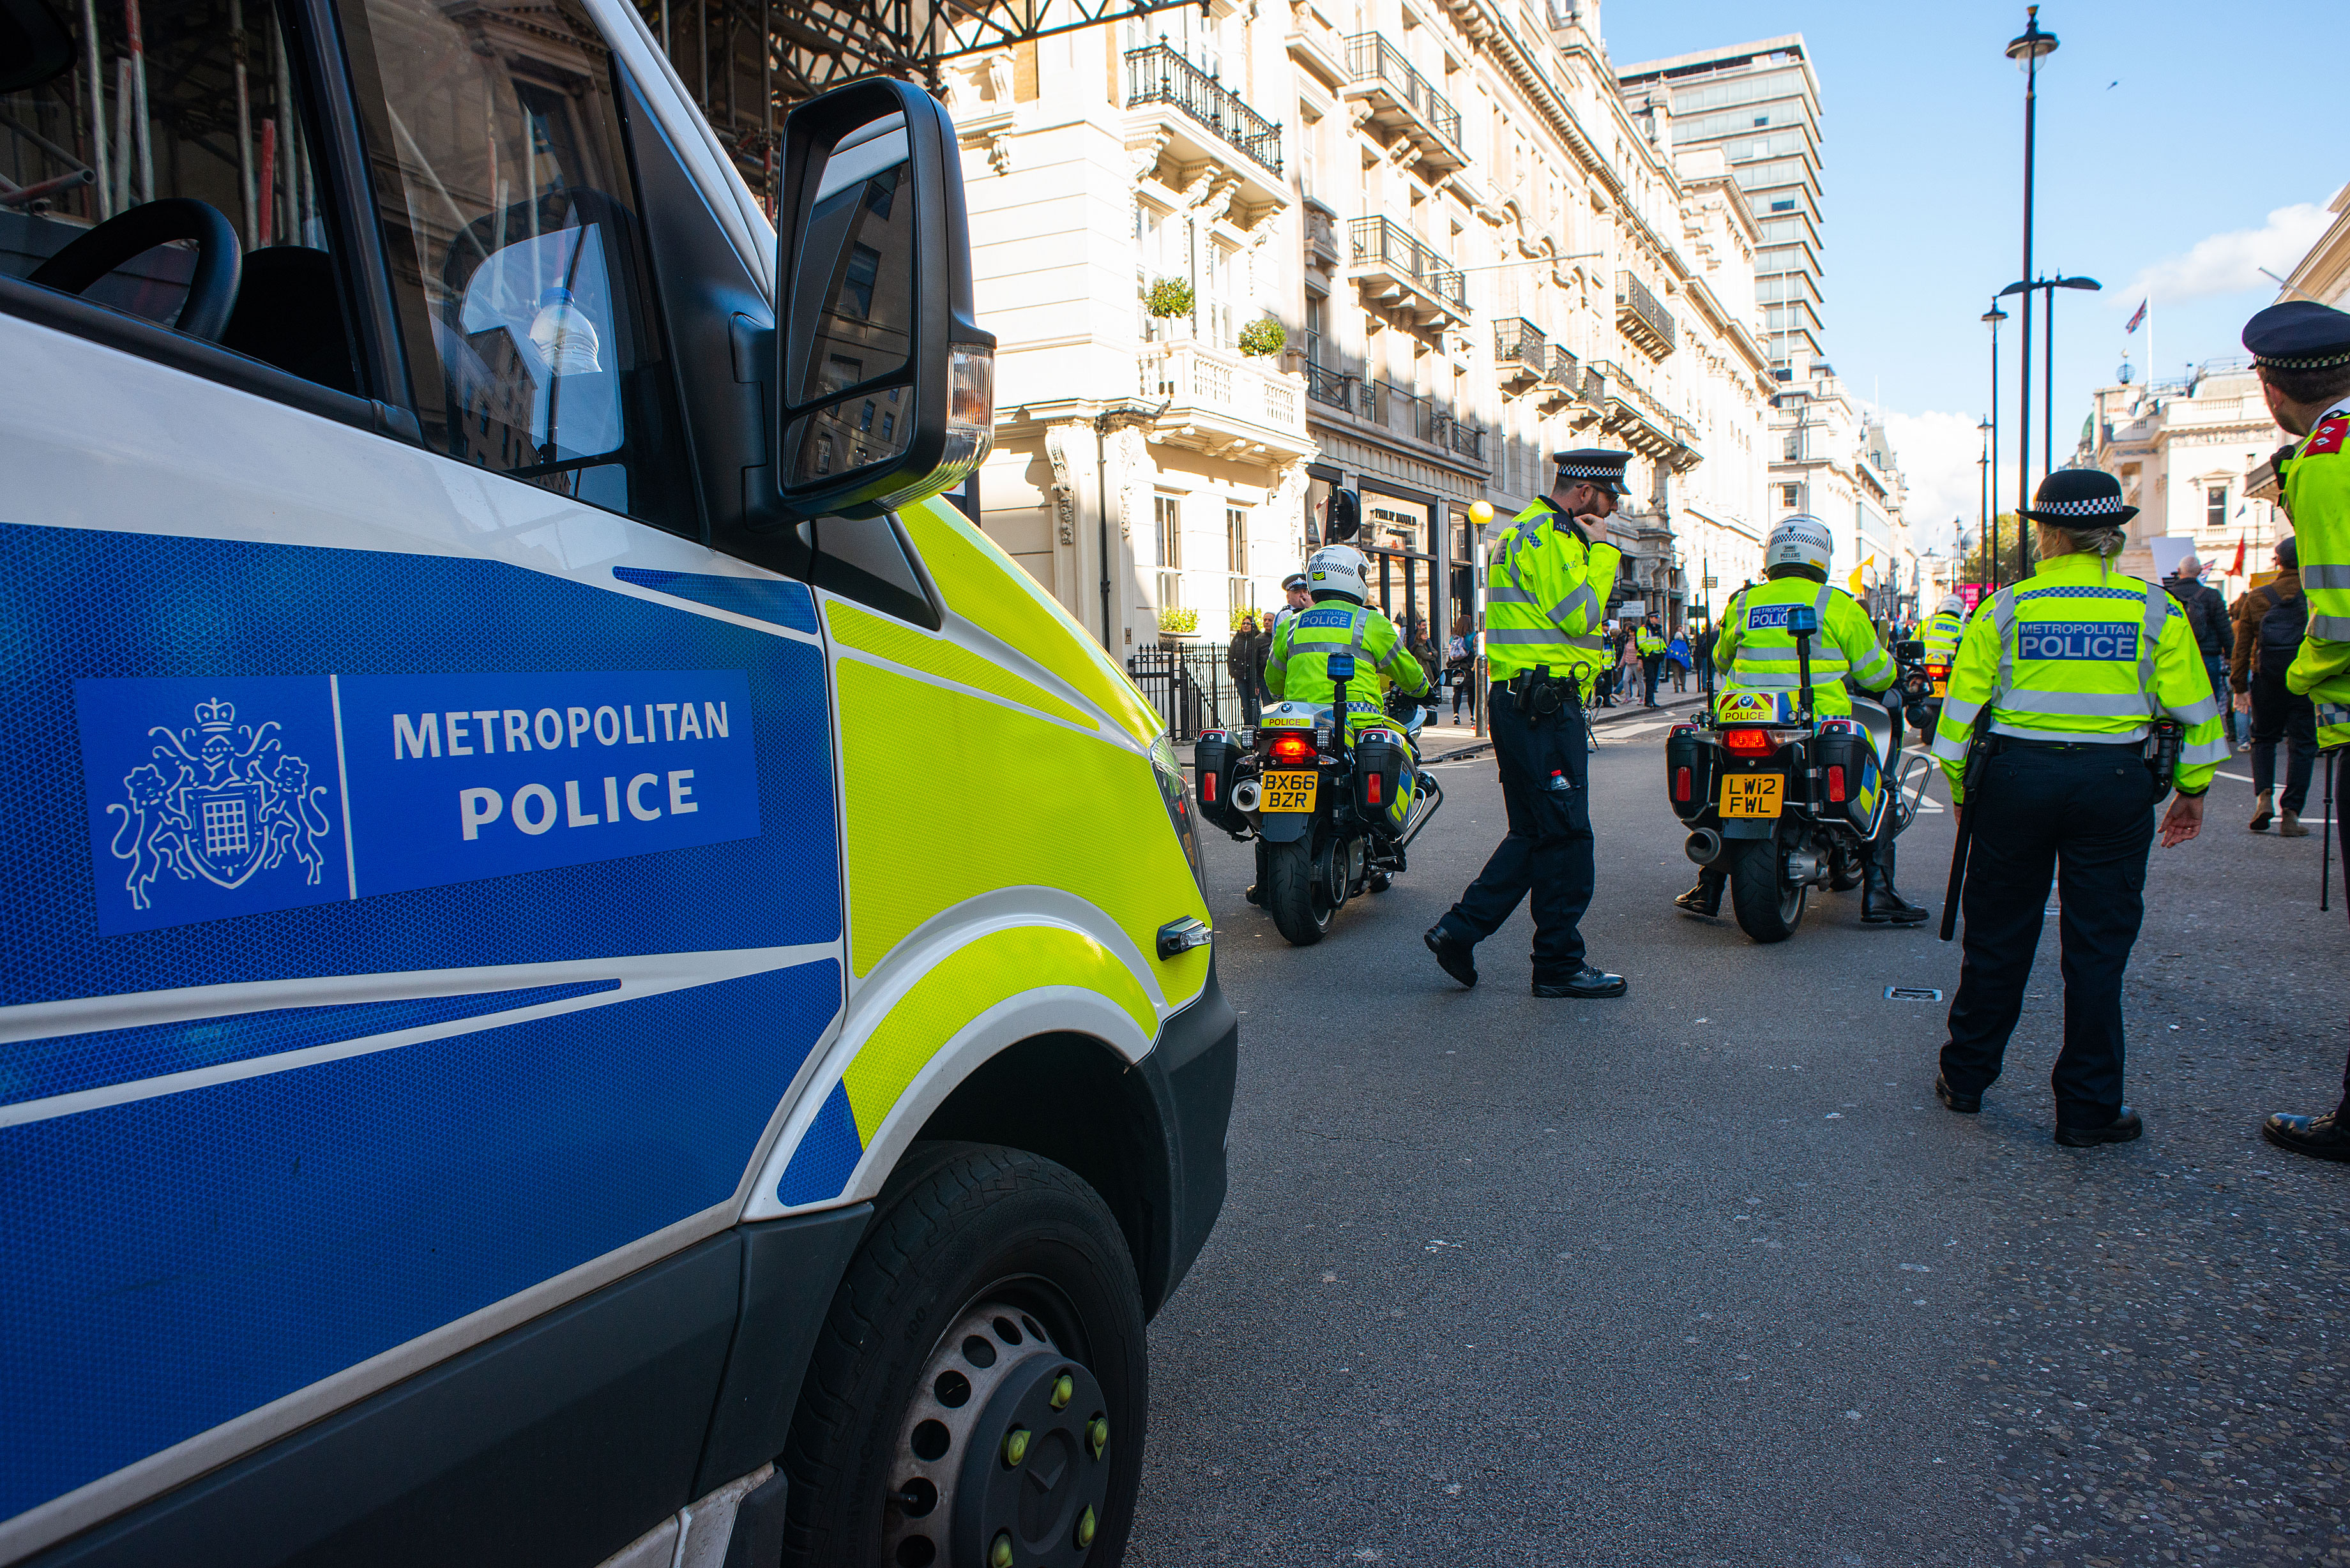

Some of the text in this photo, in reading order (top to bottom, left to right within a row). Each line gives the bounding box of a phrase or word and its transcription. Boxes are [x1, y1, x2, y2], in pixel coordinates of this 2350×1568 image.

[1375, 508, 1416, 526] PHILIP MOULD
[1561, 561, 1577, 574] POLIC
[1752, 606, 1798, 615] METROPOLI
[1301, 615, 1348, 626] POLICE
[1752, 613, 1787, 627] POLIC
[2020, 624, 2137, 635] METROPOLITAN
[2020, 636, 2135, 658] POLICE
[1725, 712, 1765, 721] POLICE
[392, 700, 730, 760] METROPOLITAN
[1264, 774, 1315, 790] BX66
[1729, 778, 1776, 795] LW12
[459, 769, 699, 841] POLICE
[1268, 792, 1307, 808] BZR
[1729, 797, 1771, 813] FWL
[903, 1306, 925, 1343] 100
